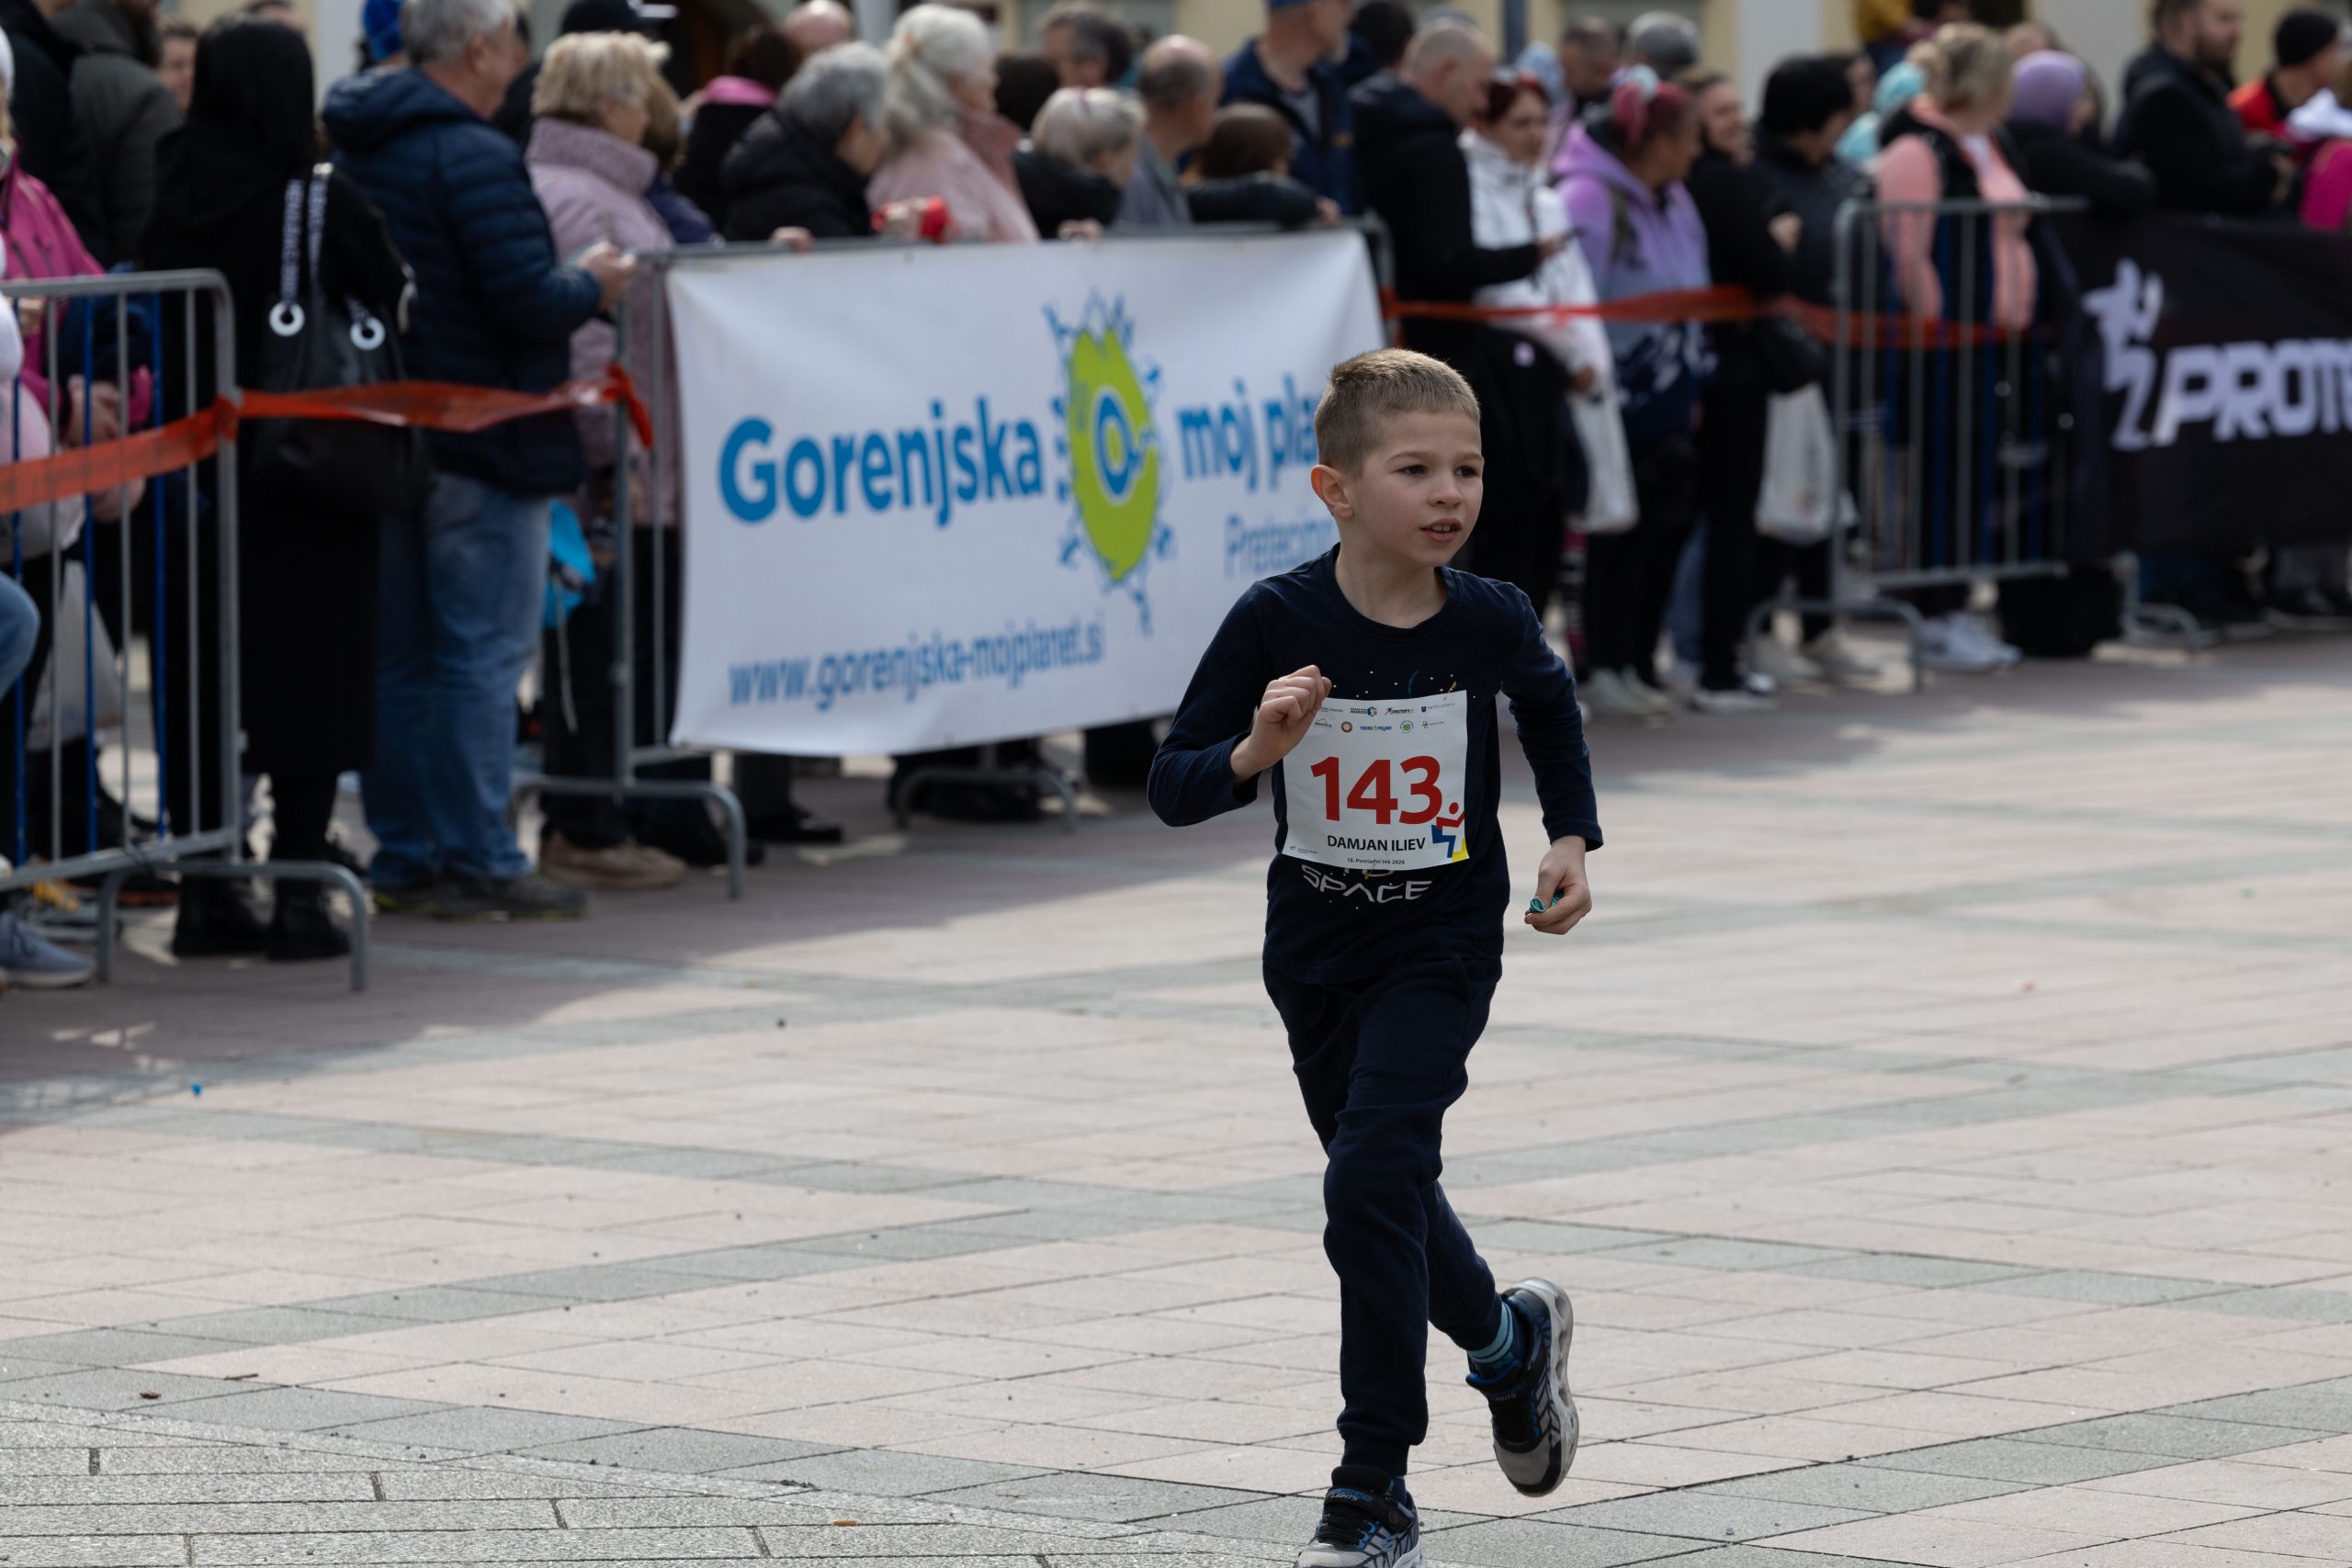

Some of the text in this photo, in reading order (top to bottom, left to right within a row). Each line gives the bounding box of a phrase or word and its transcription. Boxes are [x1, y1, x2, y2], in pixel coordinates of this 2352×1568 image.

[718, 371, 1320, 526] Gorenjska moj pla
[729, 608, 1107, 711] www.gorenjska-mojplanet.si
[1310, 755, 1442, 825] 143
[1327, 835, 1388, 852] DAMJAN
[1391, 837, 1426, 852] ILIEV
[1301, 863, 1432, 904] SPACE
